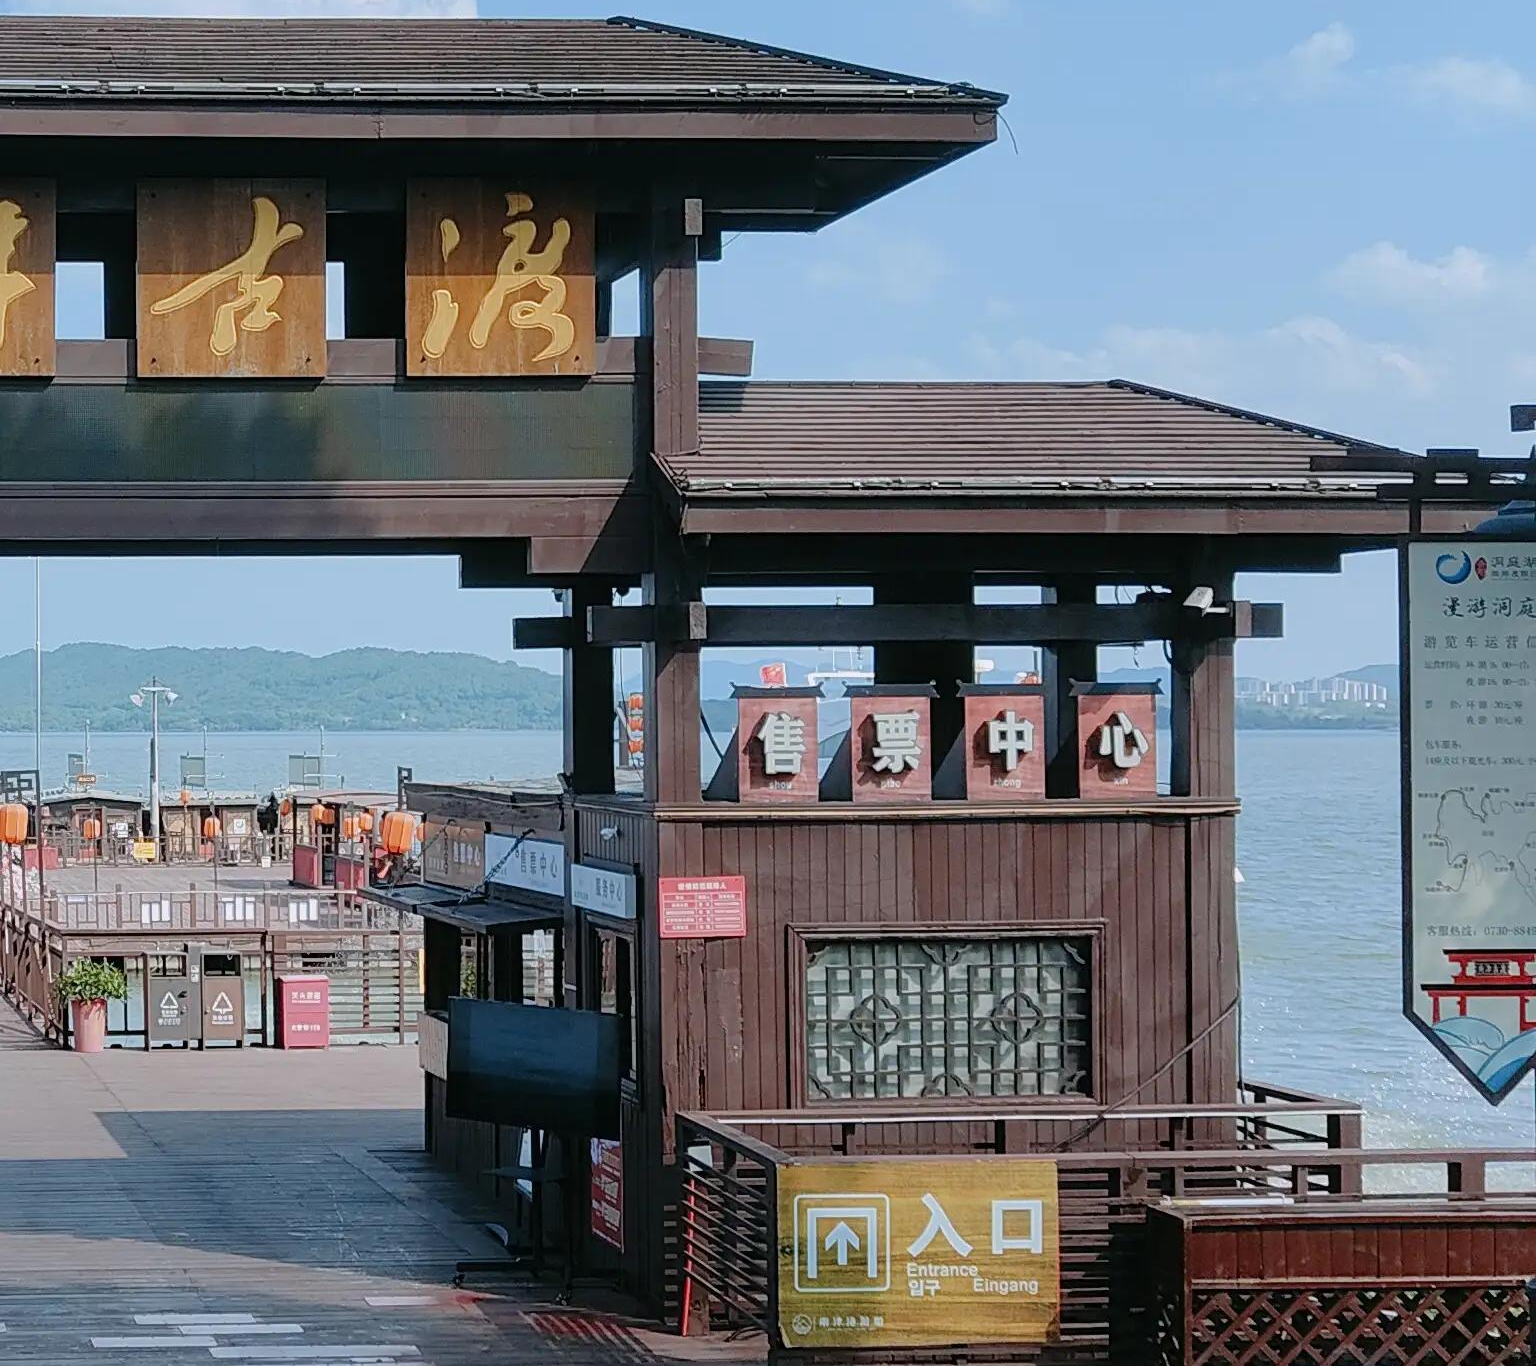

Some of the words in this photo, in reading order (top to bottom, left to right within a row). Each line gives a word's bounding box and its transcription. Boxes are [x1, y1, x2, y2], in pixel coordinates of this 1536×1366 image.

[757, 710, 1150, 775] 售票中心
[907, 1193, 1043, 1257] 入口
[907, 1262, 978, 1278] Entrance
[973, 1278, 1039, 1295] Eingang
